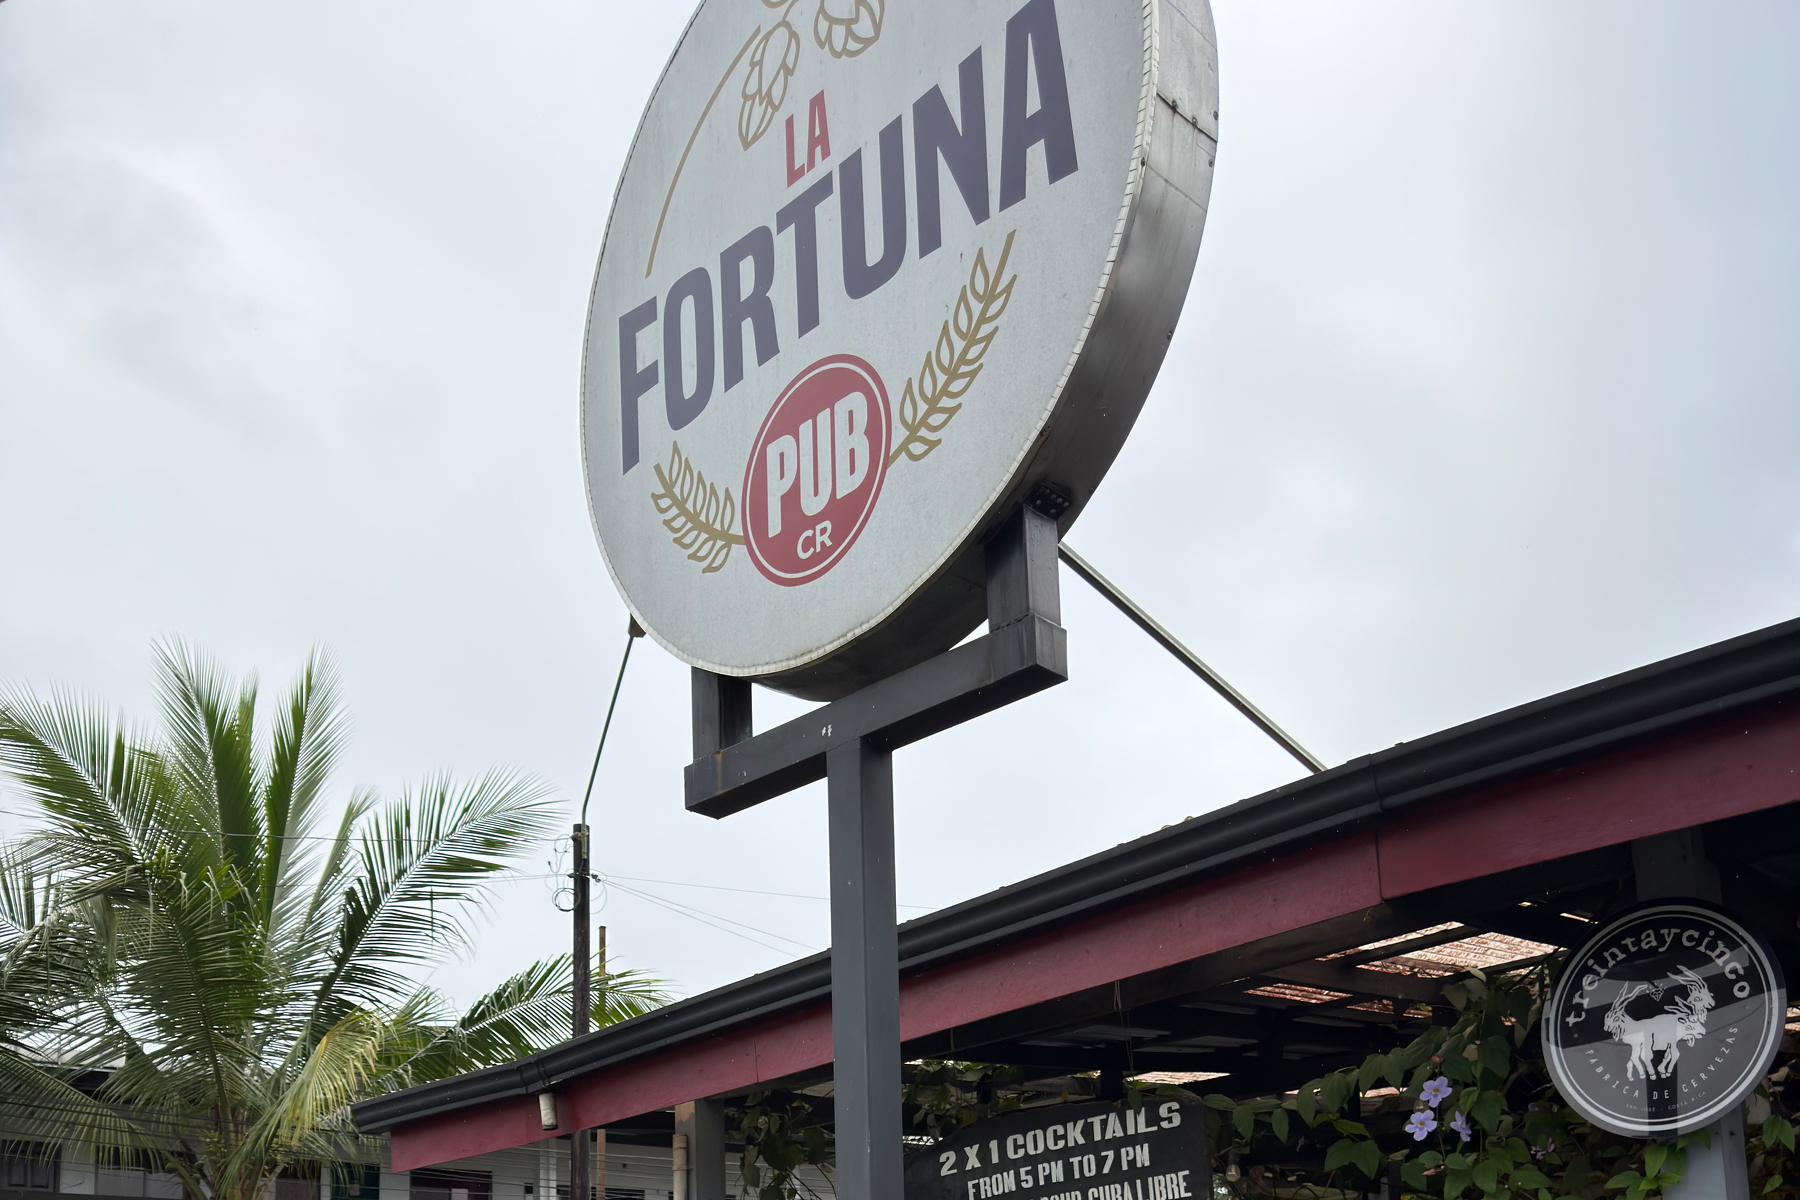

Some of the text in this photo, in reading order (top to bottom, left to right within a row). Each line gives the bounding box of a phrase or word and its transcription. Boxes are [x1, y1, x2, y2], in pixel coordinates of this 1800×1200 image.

[785, 89, 831, 188] LA
[617, 0, 1079, 476] FORTUNA
[765, 390, 870, 539] PUB
[796, 519, 833, 561] CR
[1565, 927, 1750, 1028] treintaycinco
[1652, 1089, 1670, 1100] DE
[1681, 1026, 1739, 1093] CERVEZAS
[939, 1101, 1182, 1177] 2 X 1 COCKTAILS
[1020, 1165, 1034, 1189] 5
[1038, 1159, 1065, 1187] PM
[1069, 1153, 1097, 1180] TO
[1101, 1150, 1115, 1175] 7
[1120, 1142, 1151, 1172] PM
